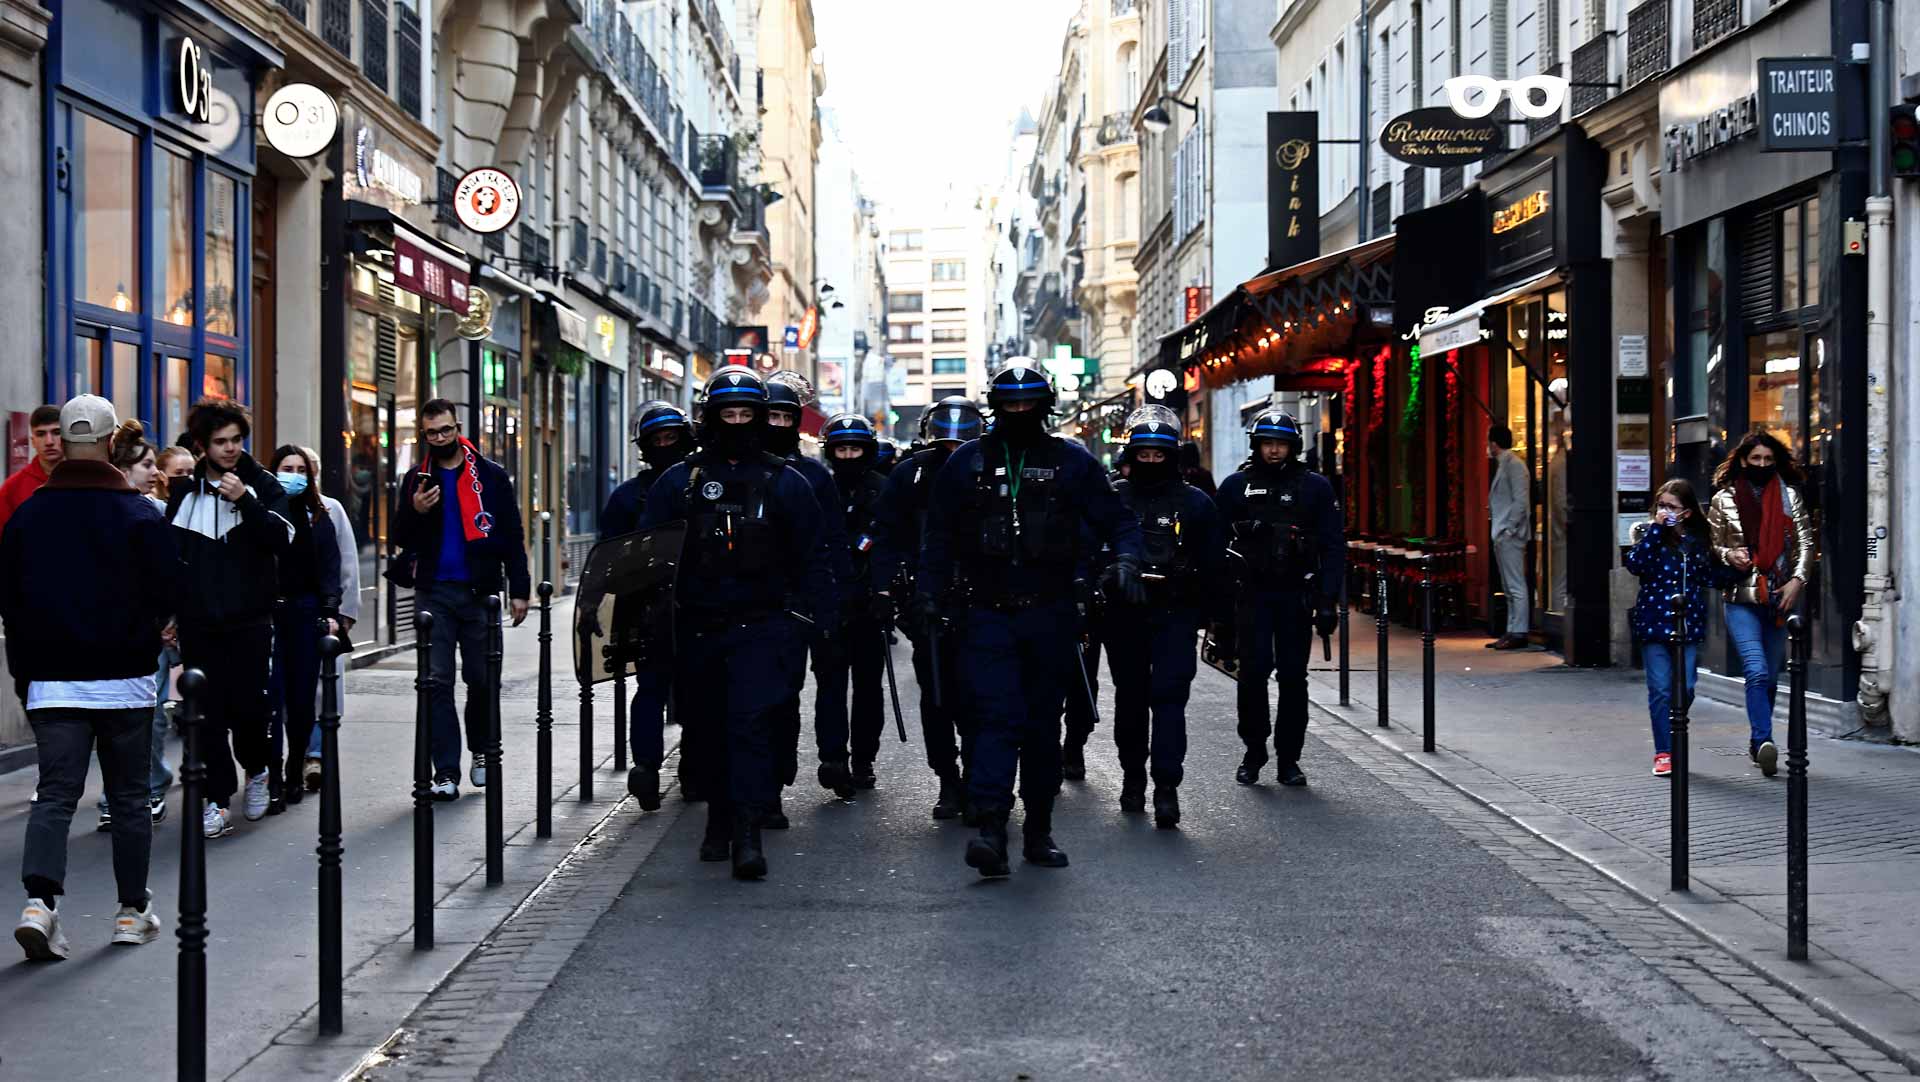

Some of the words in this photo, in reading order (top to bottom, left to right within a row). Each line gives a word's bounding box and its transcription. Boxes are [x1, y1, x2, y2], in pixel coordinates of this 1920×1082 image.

[1769, 69, 1834, 94] TRAITEUR
[1388, 120, 1495, 142] Restaurant
[1773, 111, 1831, 136] CHINOIS
